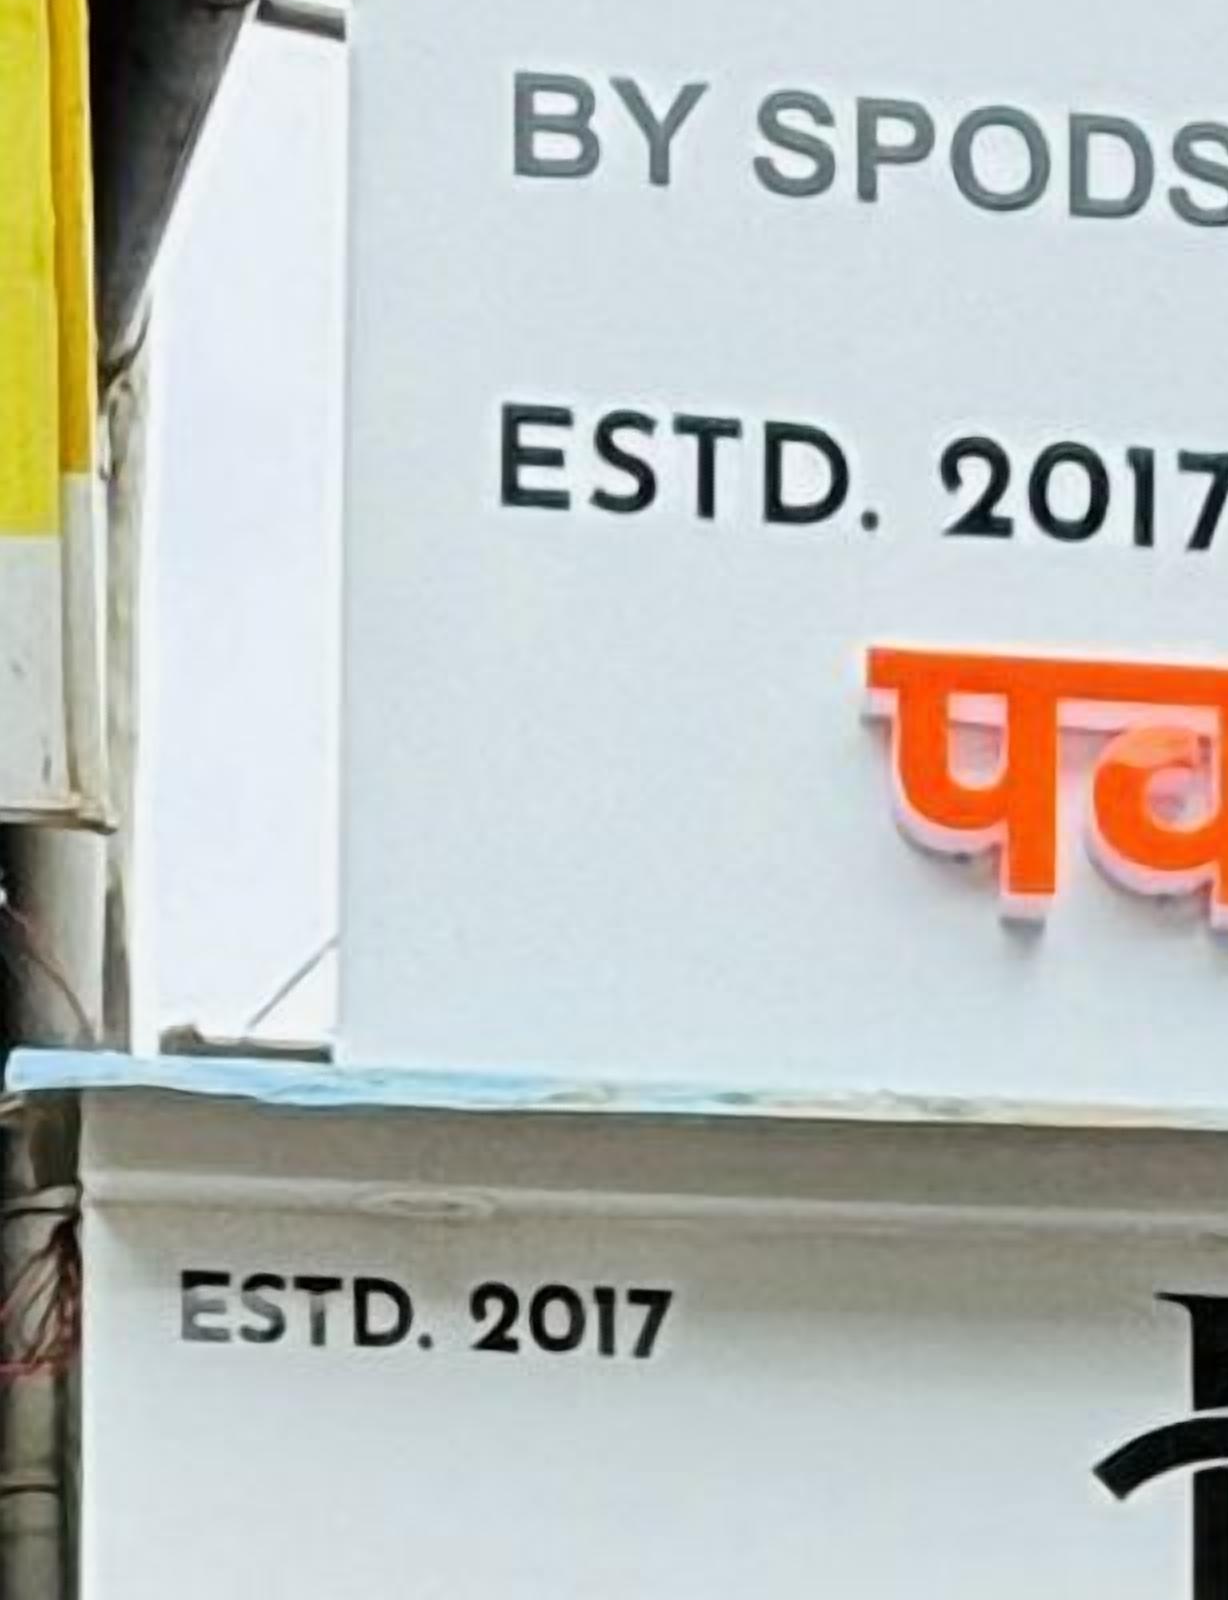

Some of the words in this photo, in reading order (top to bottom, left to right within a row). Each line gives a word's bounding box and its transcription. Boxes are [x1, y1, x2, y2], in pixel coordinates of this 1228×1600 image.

[513, 71, 709, 188] BY
[500, 402, 881, 532] ESTD.
[179, 1269, 434, 1351] ESTD.
[469, 1280, 675, 1359] 2017
